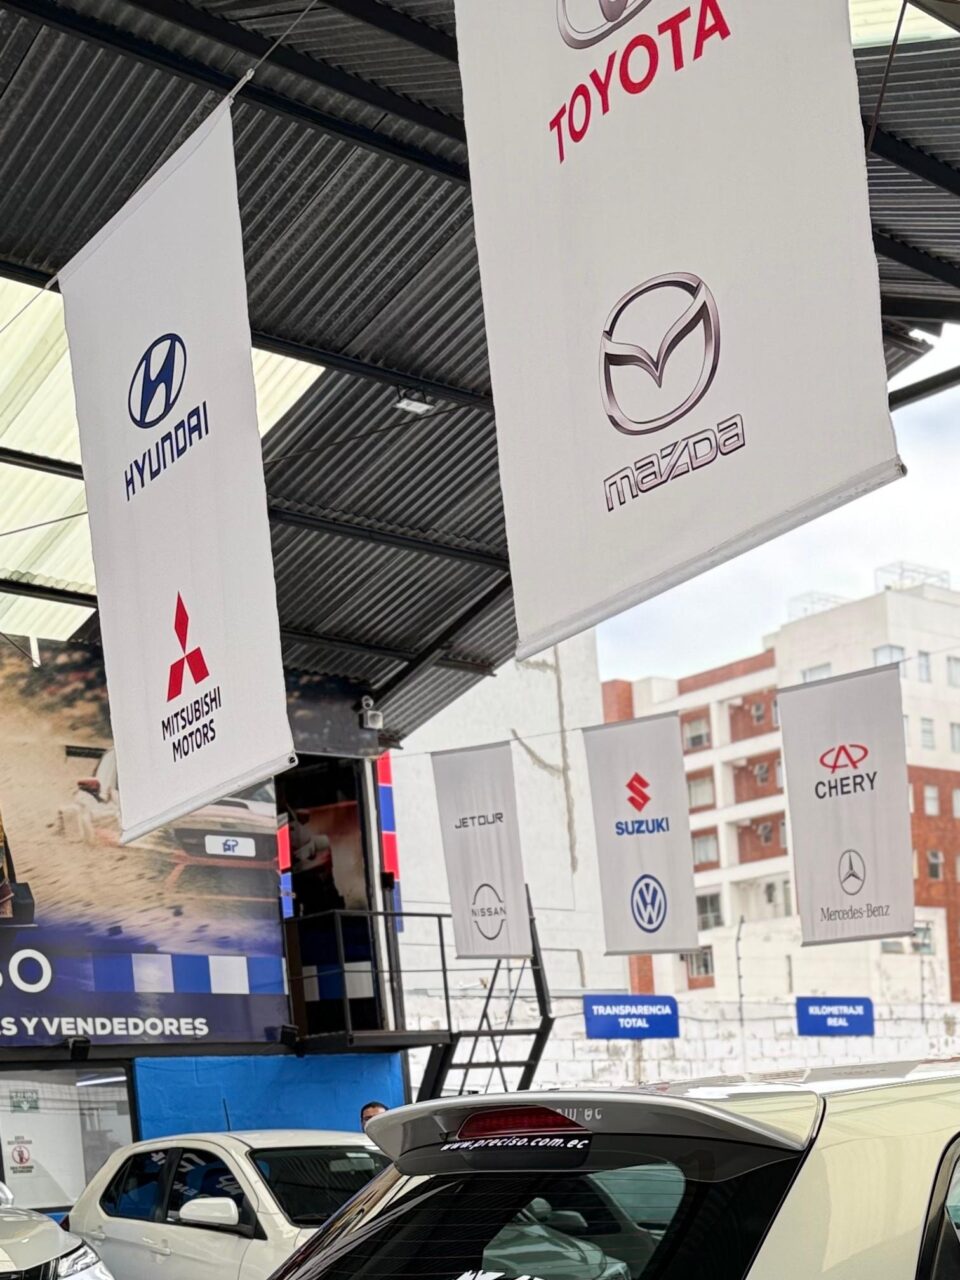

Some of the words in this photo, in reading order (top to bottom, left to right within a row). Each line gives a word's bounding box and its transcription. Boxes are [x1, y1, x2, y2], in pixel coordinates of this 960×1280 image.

[549, 0, 731, 164] TOYOTA
[124, 400, 210, 502] HYUNDAI
[161, 685, 222, 741] MITSUBISHI
[172, 721, 217, 763] MOTORS
[814, 771, 878, 800] CHERY
[454, 811, 504, 829] JETOUR
[615, 816, 670, 836] SUZUKI
[471, 906, 507, 918] NISSAN
[819, 903, 890, 922] Mercedes-Benz
[0, 948, 52, 994] O
[592, 1004, 672, 1016] TRANSPARENCIA
[808, 1005, 864, 1015] KILOMETRAJE
[20, 1016, 39, 1036] Y
[41, 1016, 209, 1036] VENDEDORES
[618, 1017, 650, 1028] TOTAL
[826, 1017, 849, 1027] REAL
[440, 1135, 589, 1151] www.preciso.com.ec
